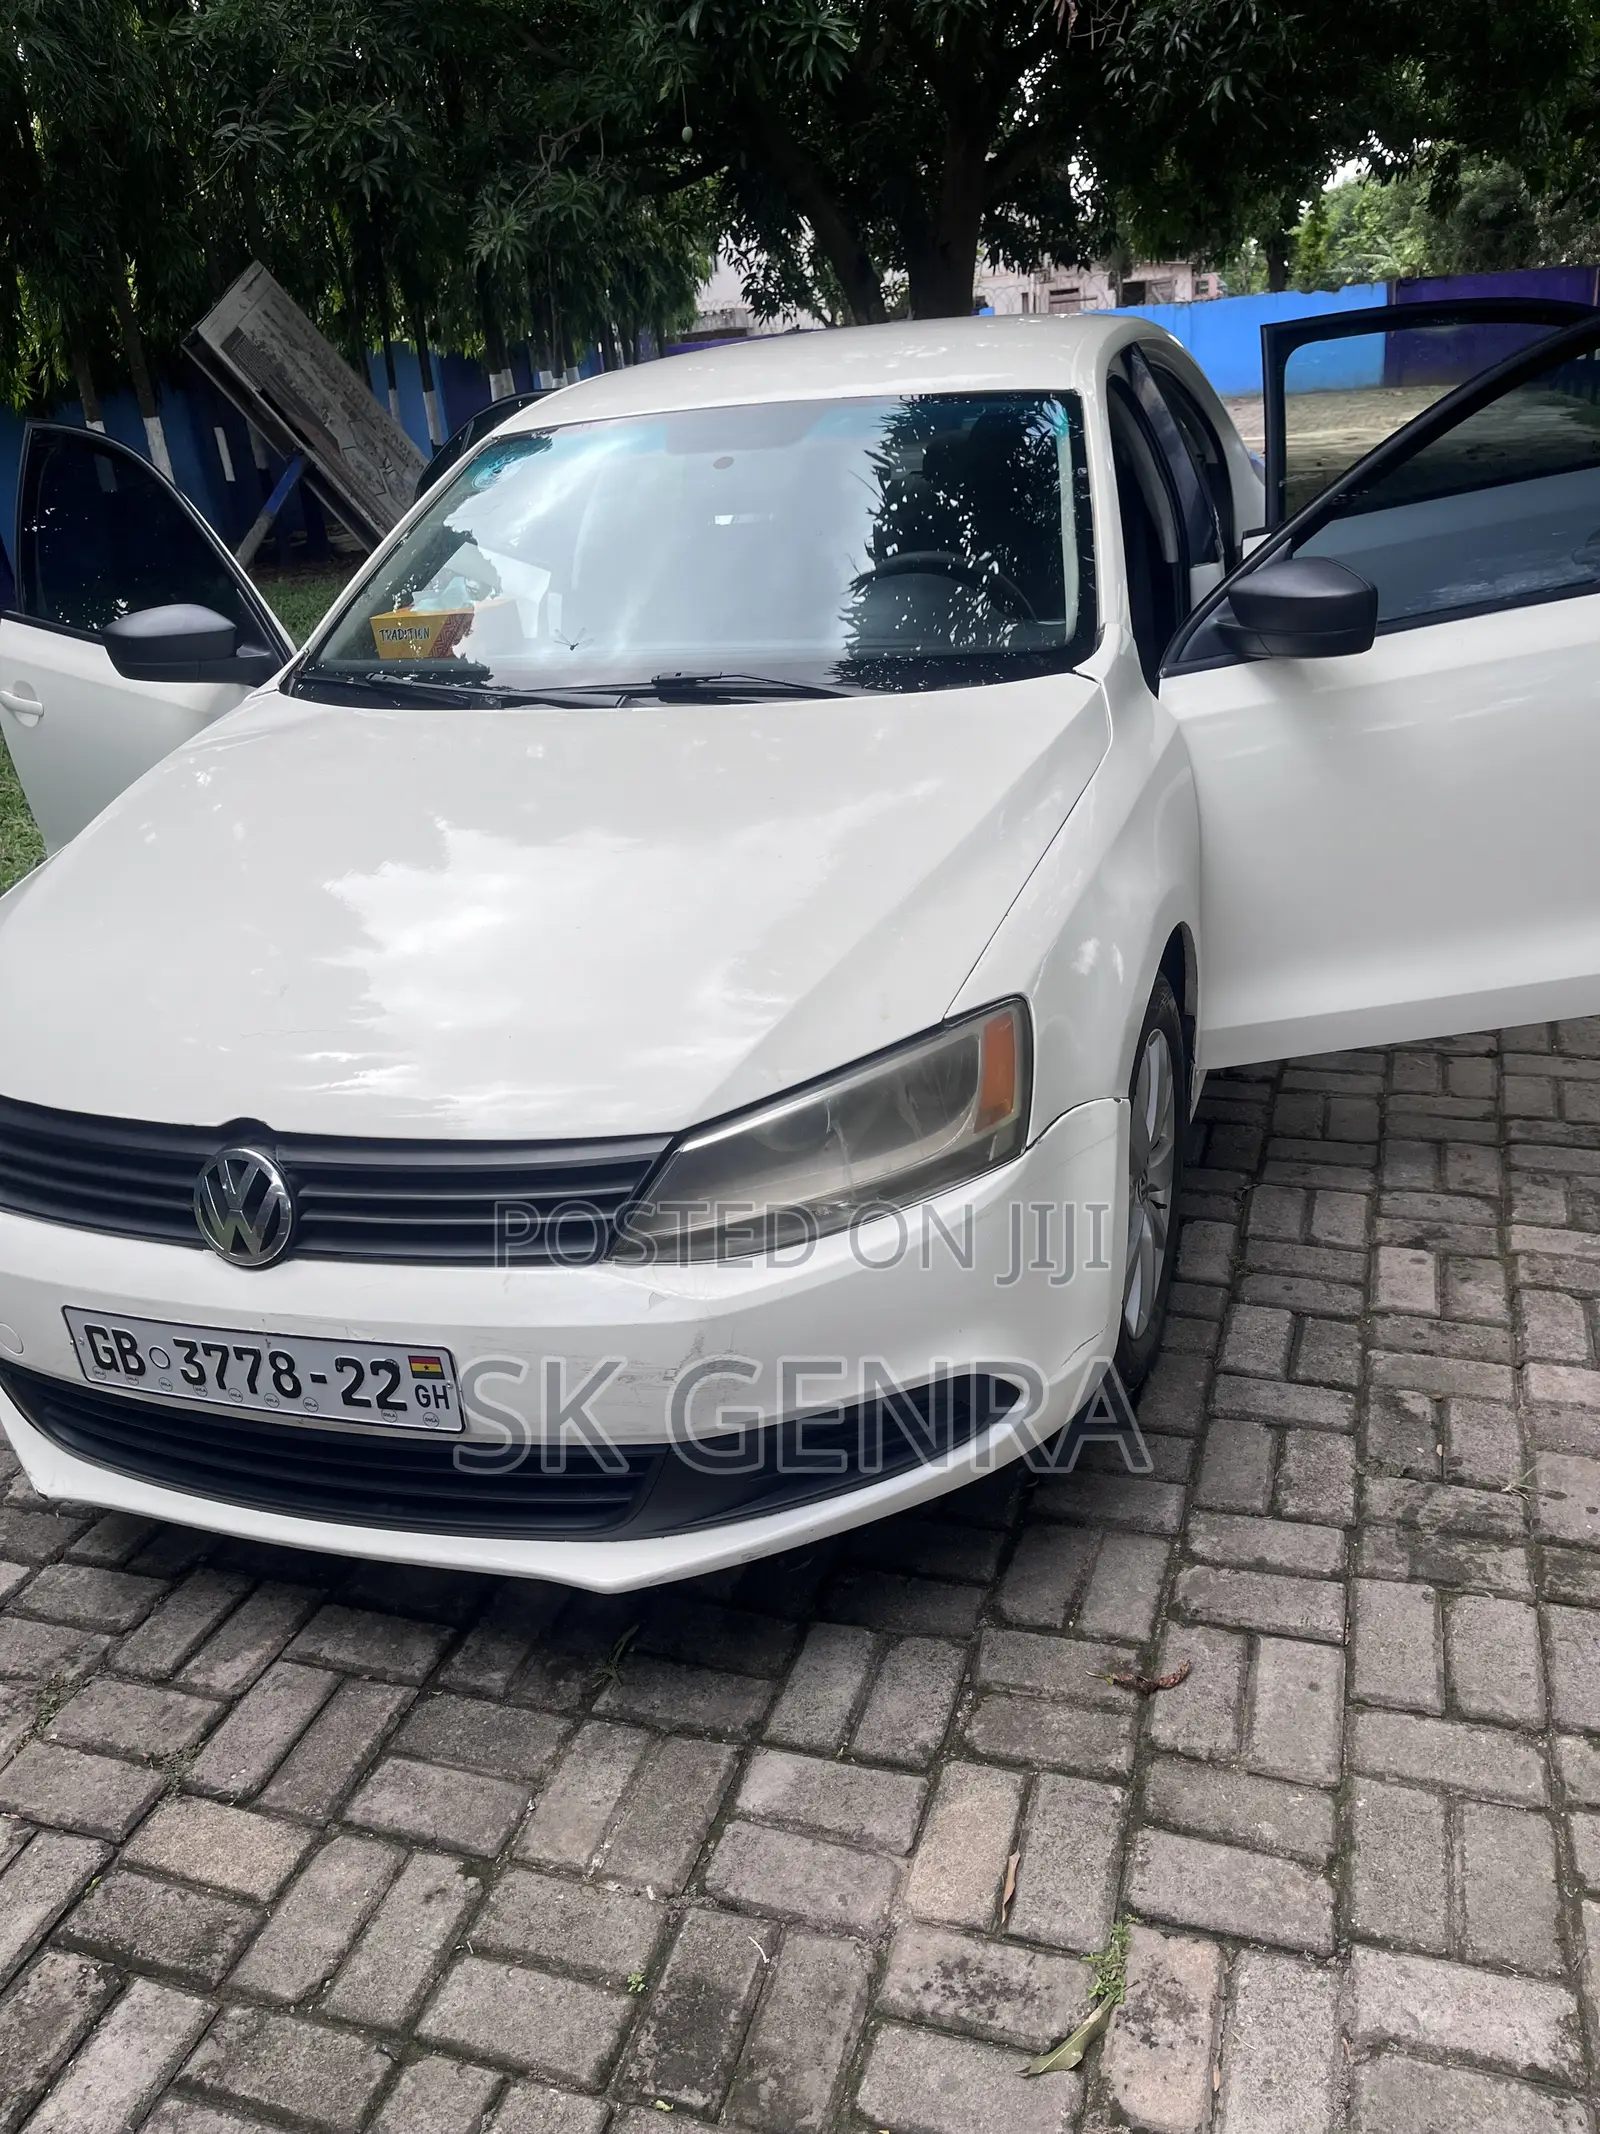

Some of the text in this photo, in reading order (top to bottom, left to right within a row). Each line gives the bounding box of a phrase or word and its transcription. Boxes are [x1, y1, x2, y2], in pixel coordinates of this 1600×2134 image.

[378, 626, 431, 642] TRADITION
[83, 1324, 147, 1377] GB
[414, 1384, 450, 1410] GH
